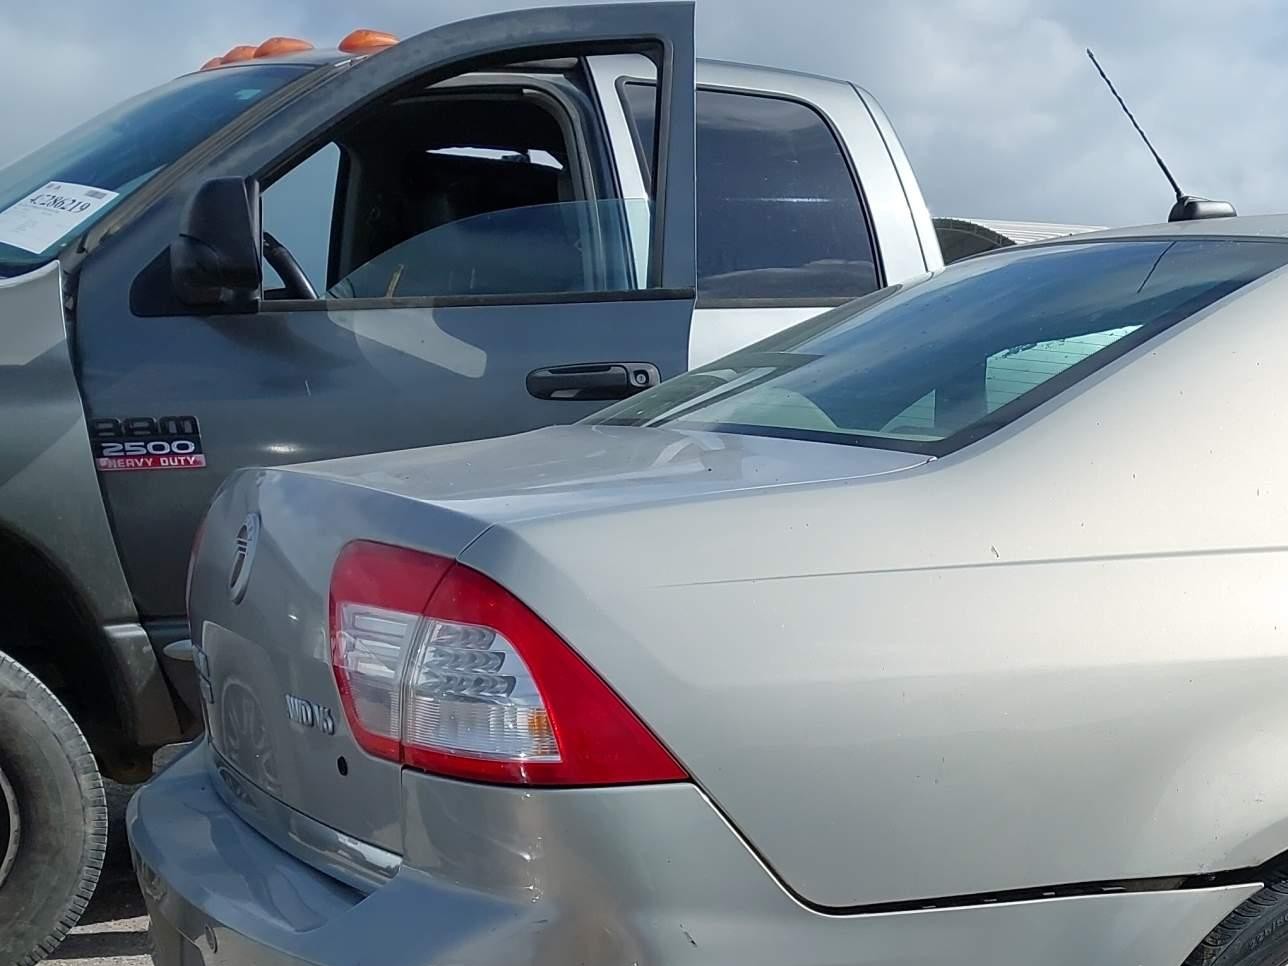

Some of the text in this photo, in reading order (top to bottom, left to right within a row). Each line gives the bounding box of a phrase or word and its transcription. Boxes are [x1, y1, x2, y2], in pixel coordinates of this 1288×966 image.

[101, 440, 196, 456] 2500
[107, 456, 196, 469] HEAVY DUTY
